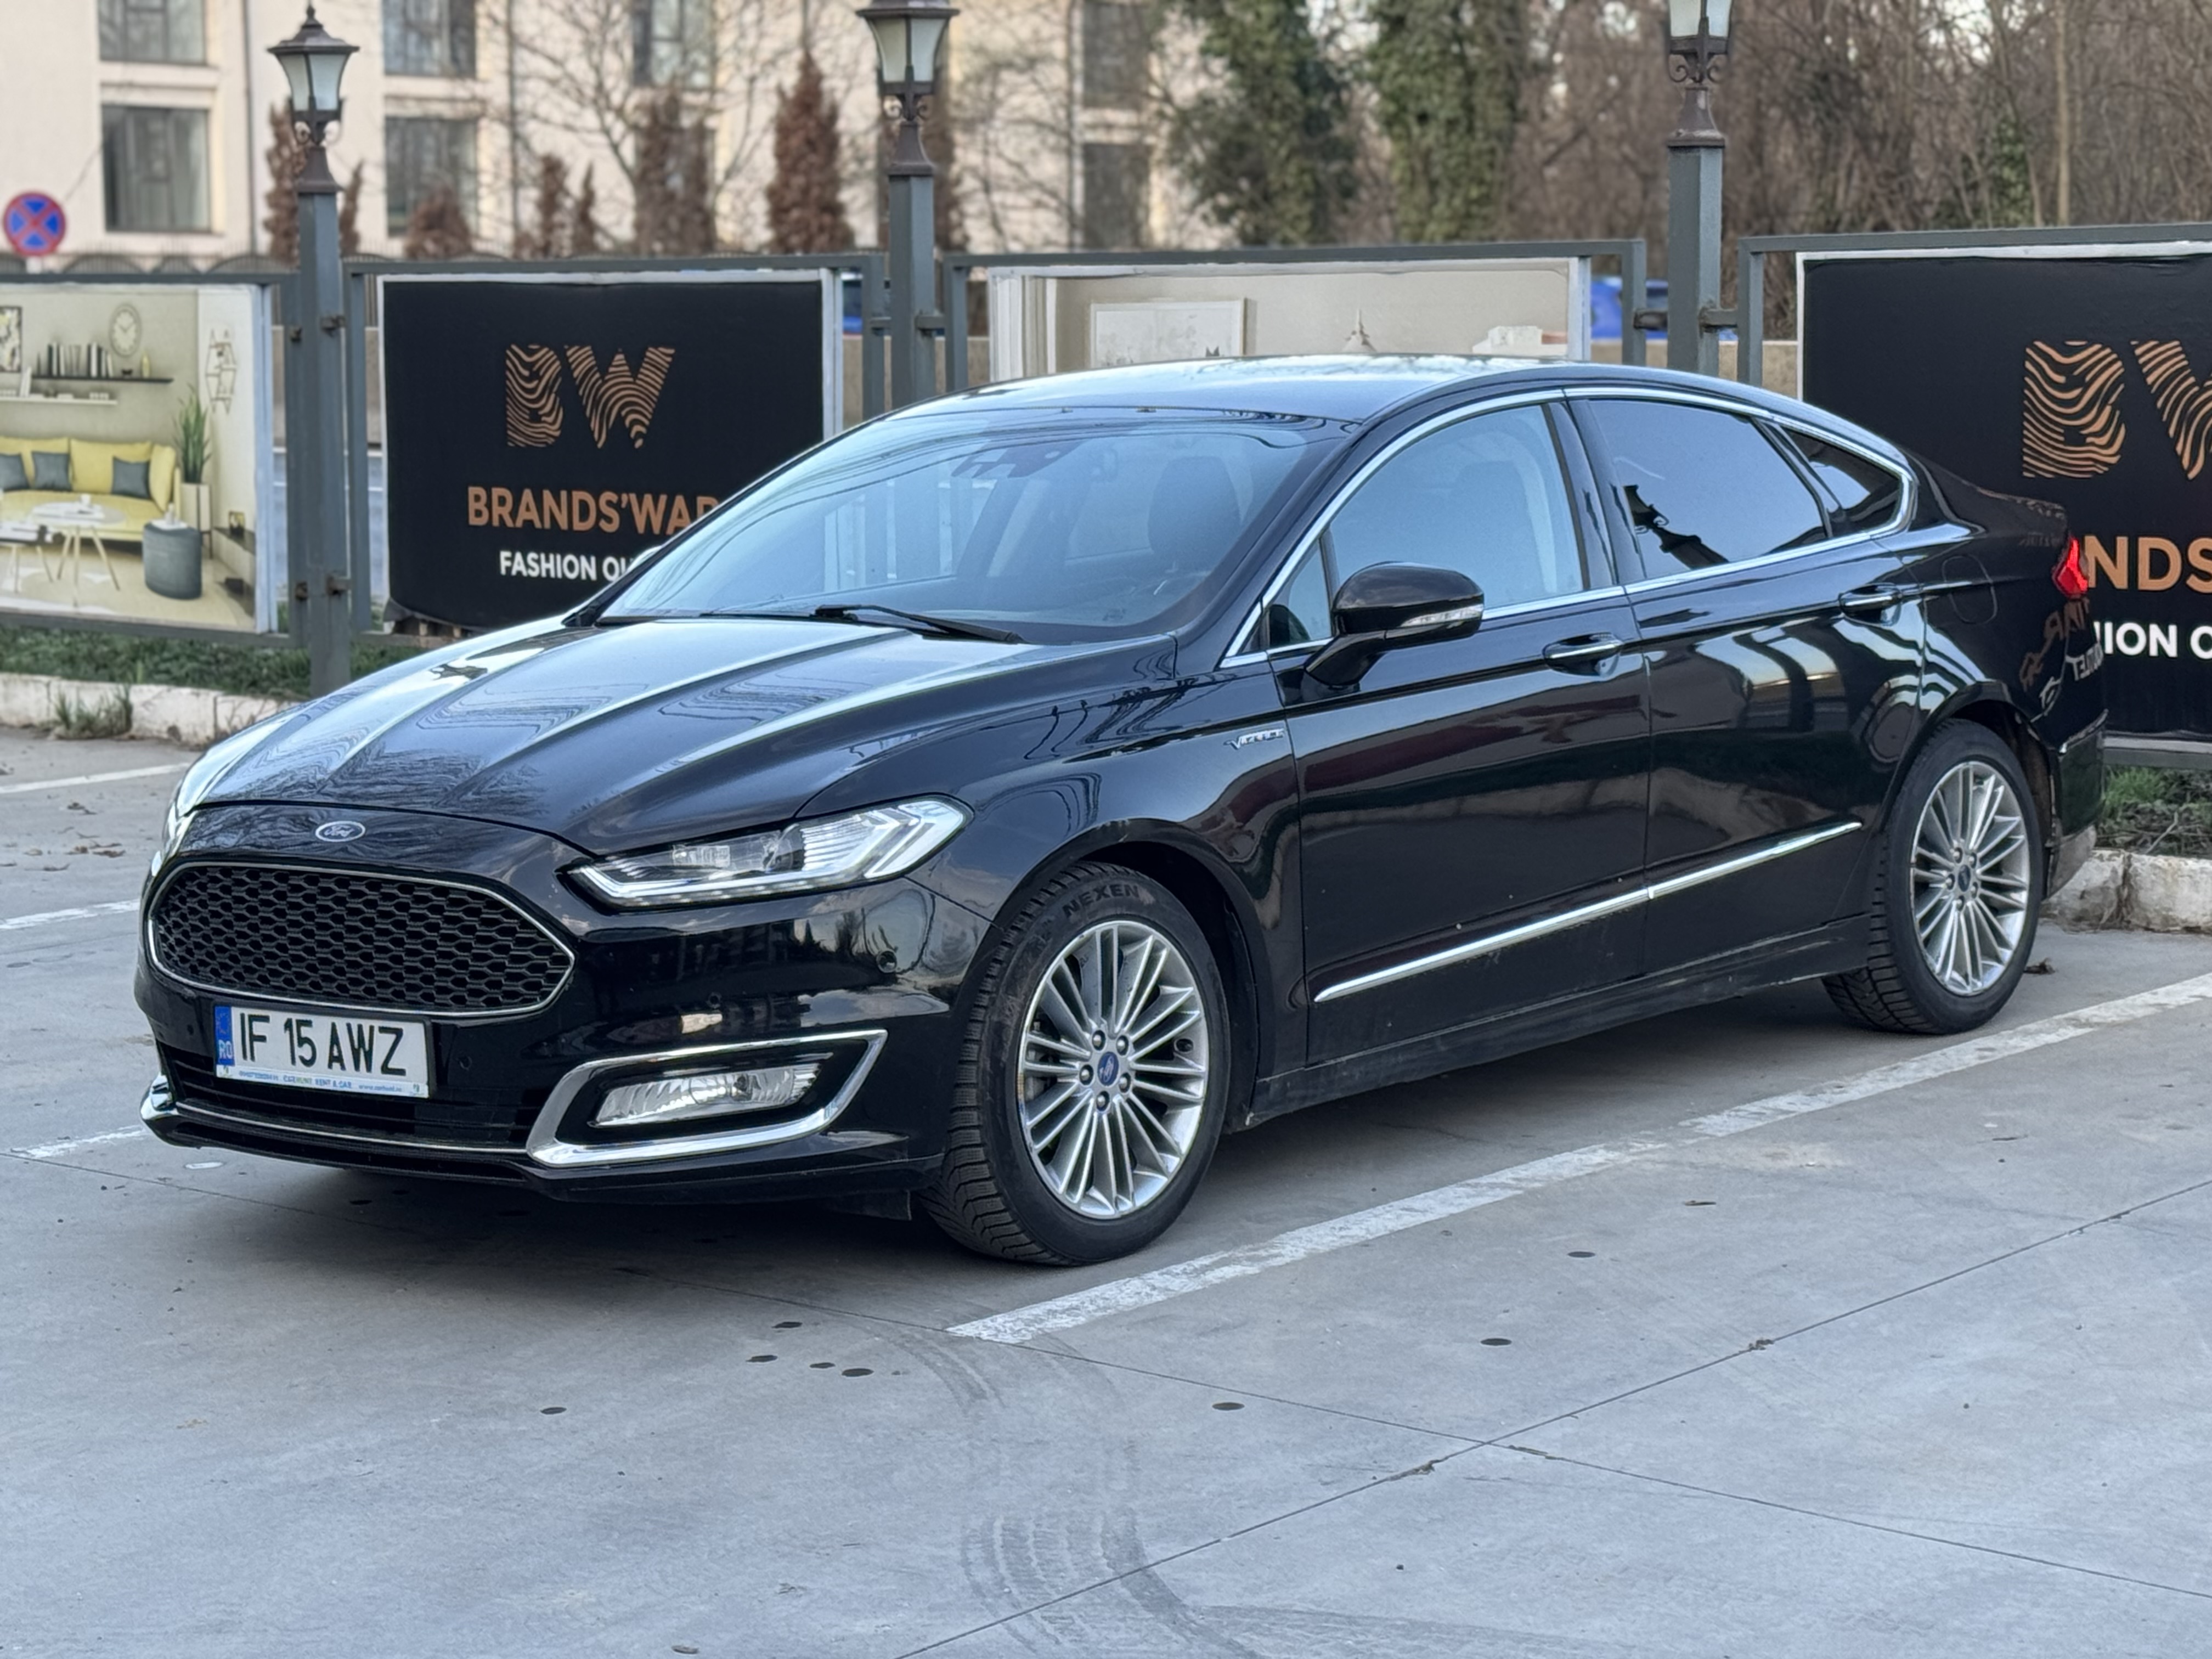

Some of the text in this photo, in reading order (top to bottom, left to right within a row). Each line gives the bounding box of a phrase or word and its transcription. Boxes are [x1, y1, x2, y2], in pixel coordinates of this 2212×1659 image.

[505, 344, 675, 448] BW
[500, 551, 596, 581] FASHION
[2094, 621, 2178, 657] ION
[1063, 884, 1139, 917] NEXEN
[240, 1013, 407, 1076] IF 15 AWZ
